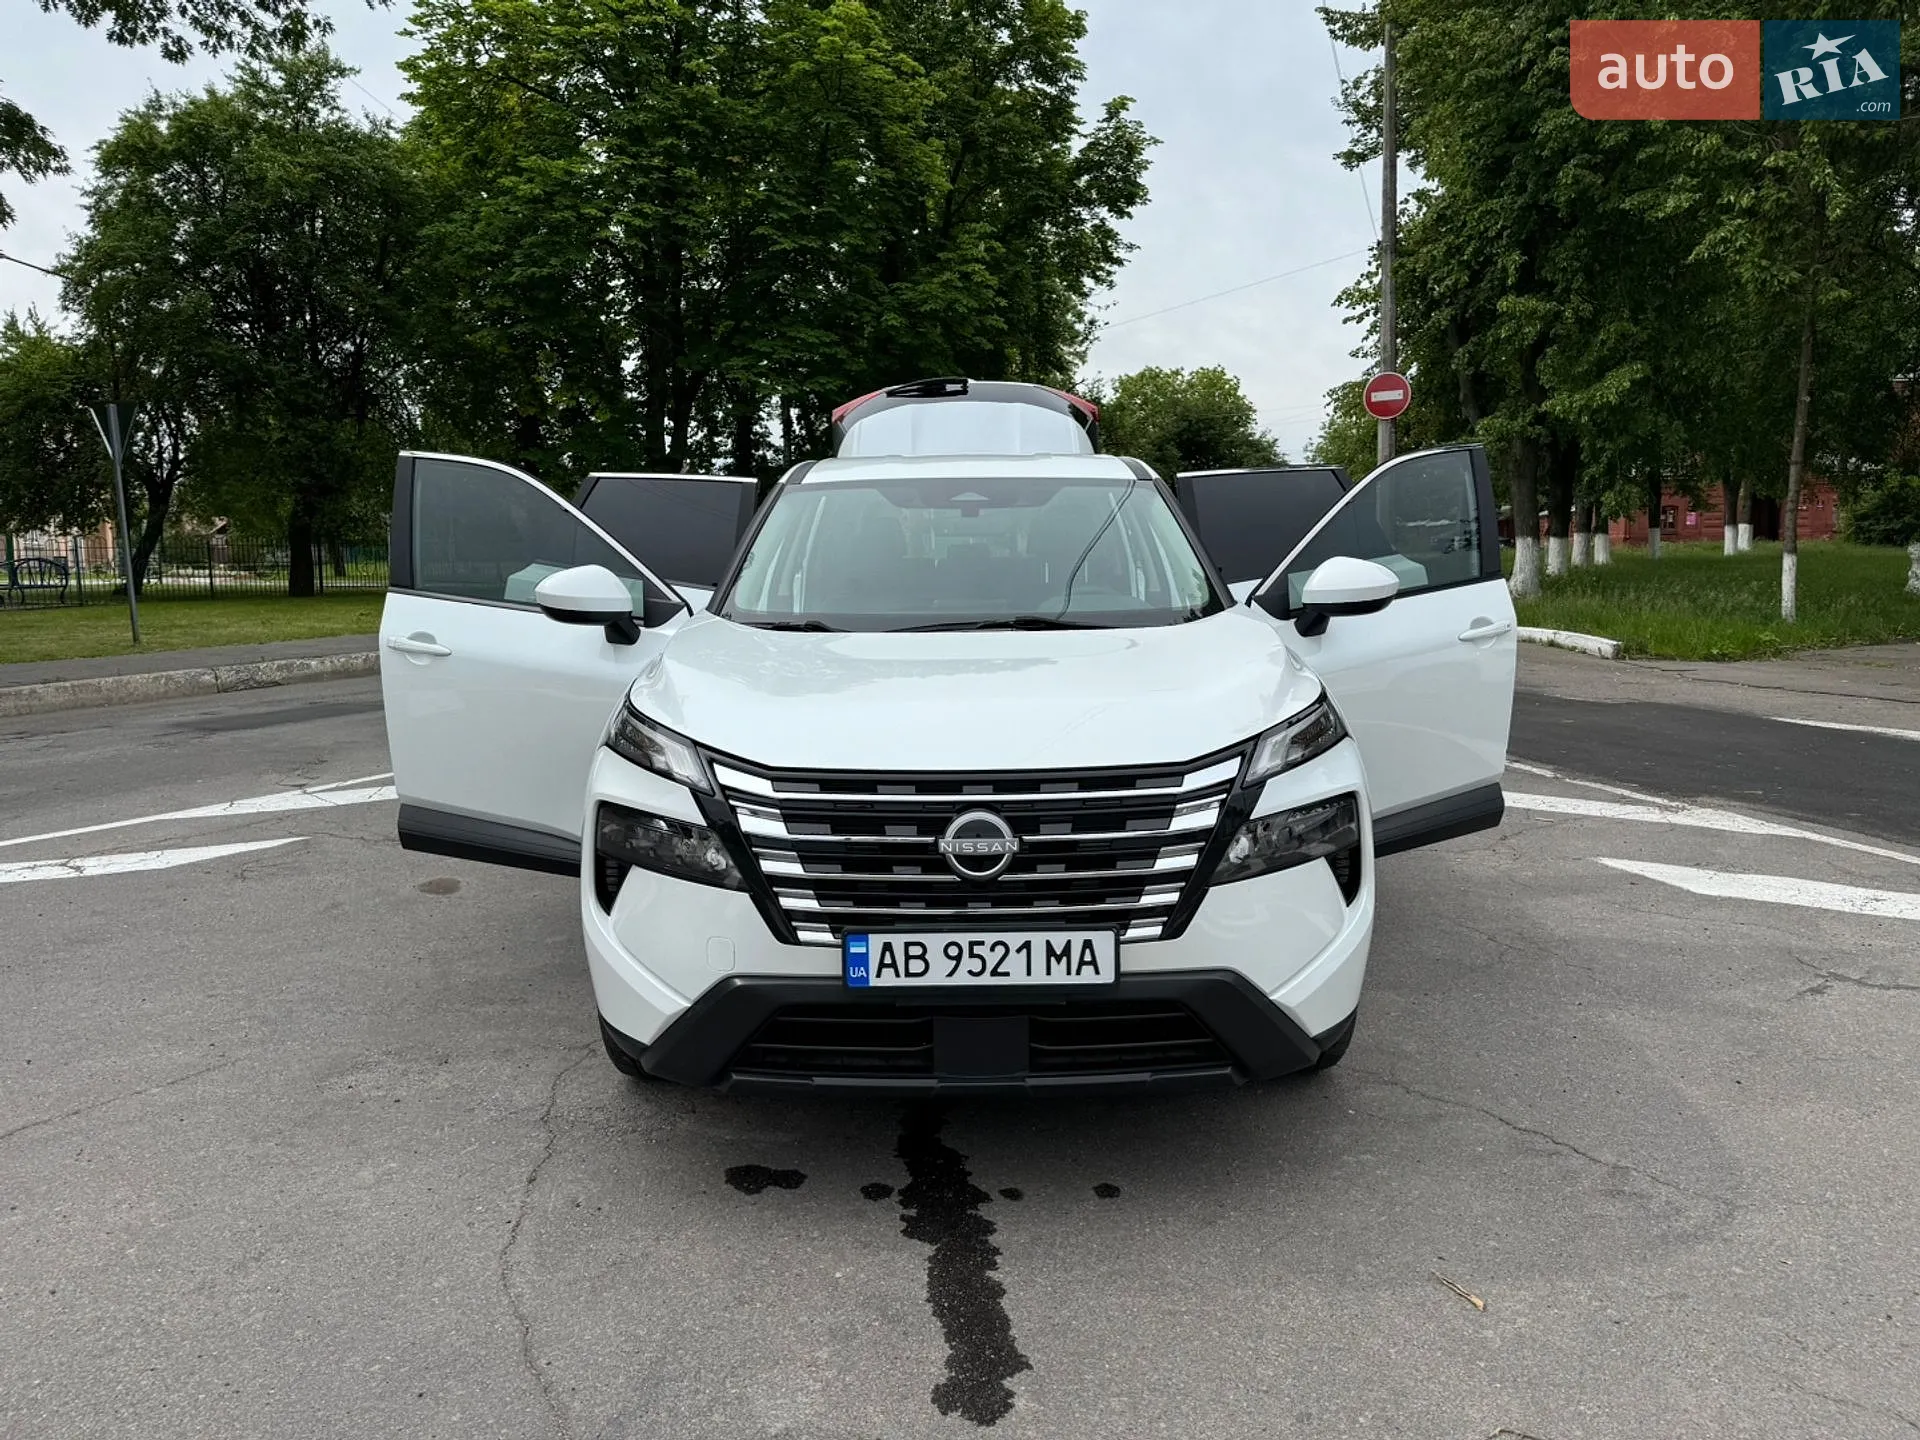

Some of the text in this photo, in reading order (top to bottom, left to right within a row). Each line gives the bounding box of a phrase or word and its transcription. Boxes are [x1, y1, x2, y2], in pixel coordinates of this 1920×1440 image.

[941, 842, 1018, 853] NISSAN
[875, 939, 1100, 978] AB 9521 MA
[849, 966, 867, 978] UA
